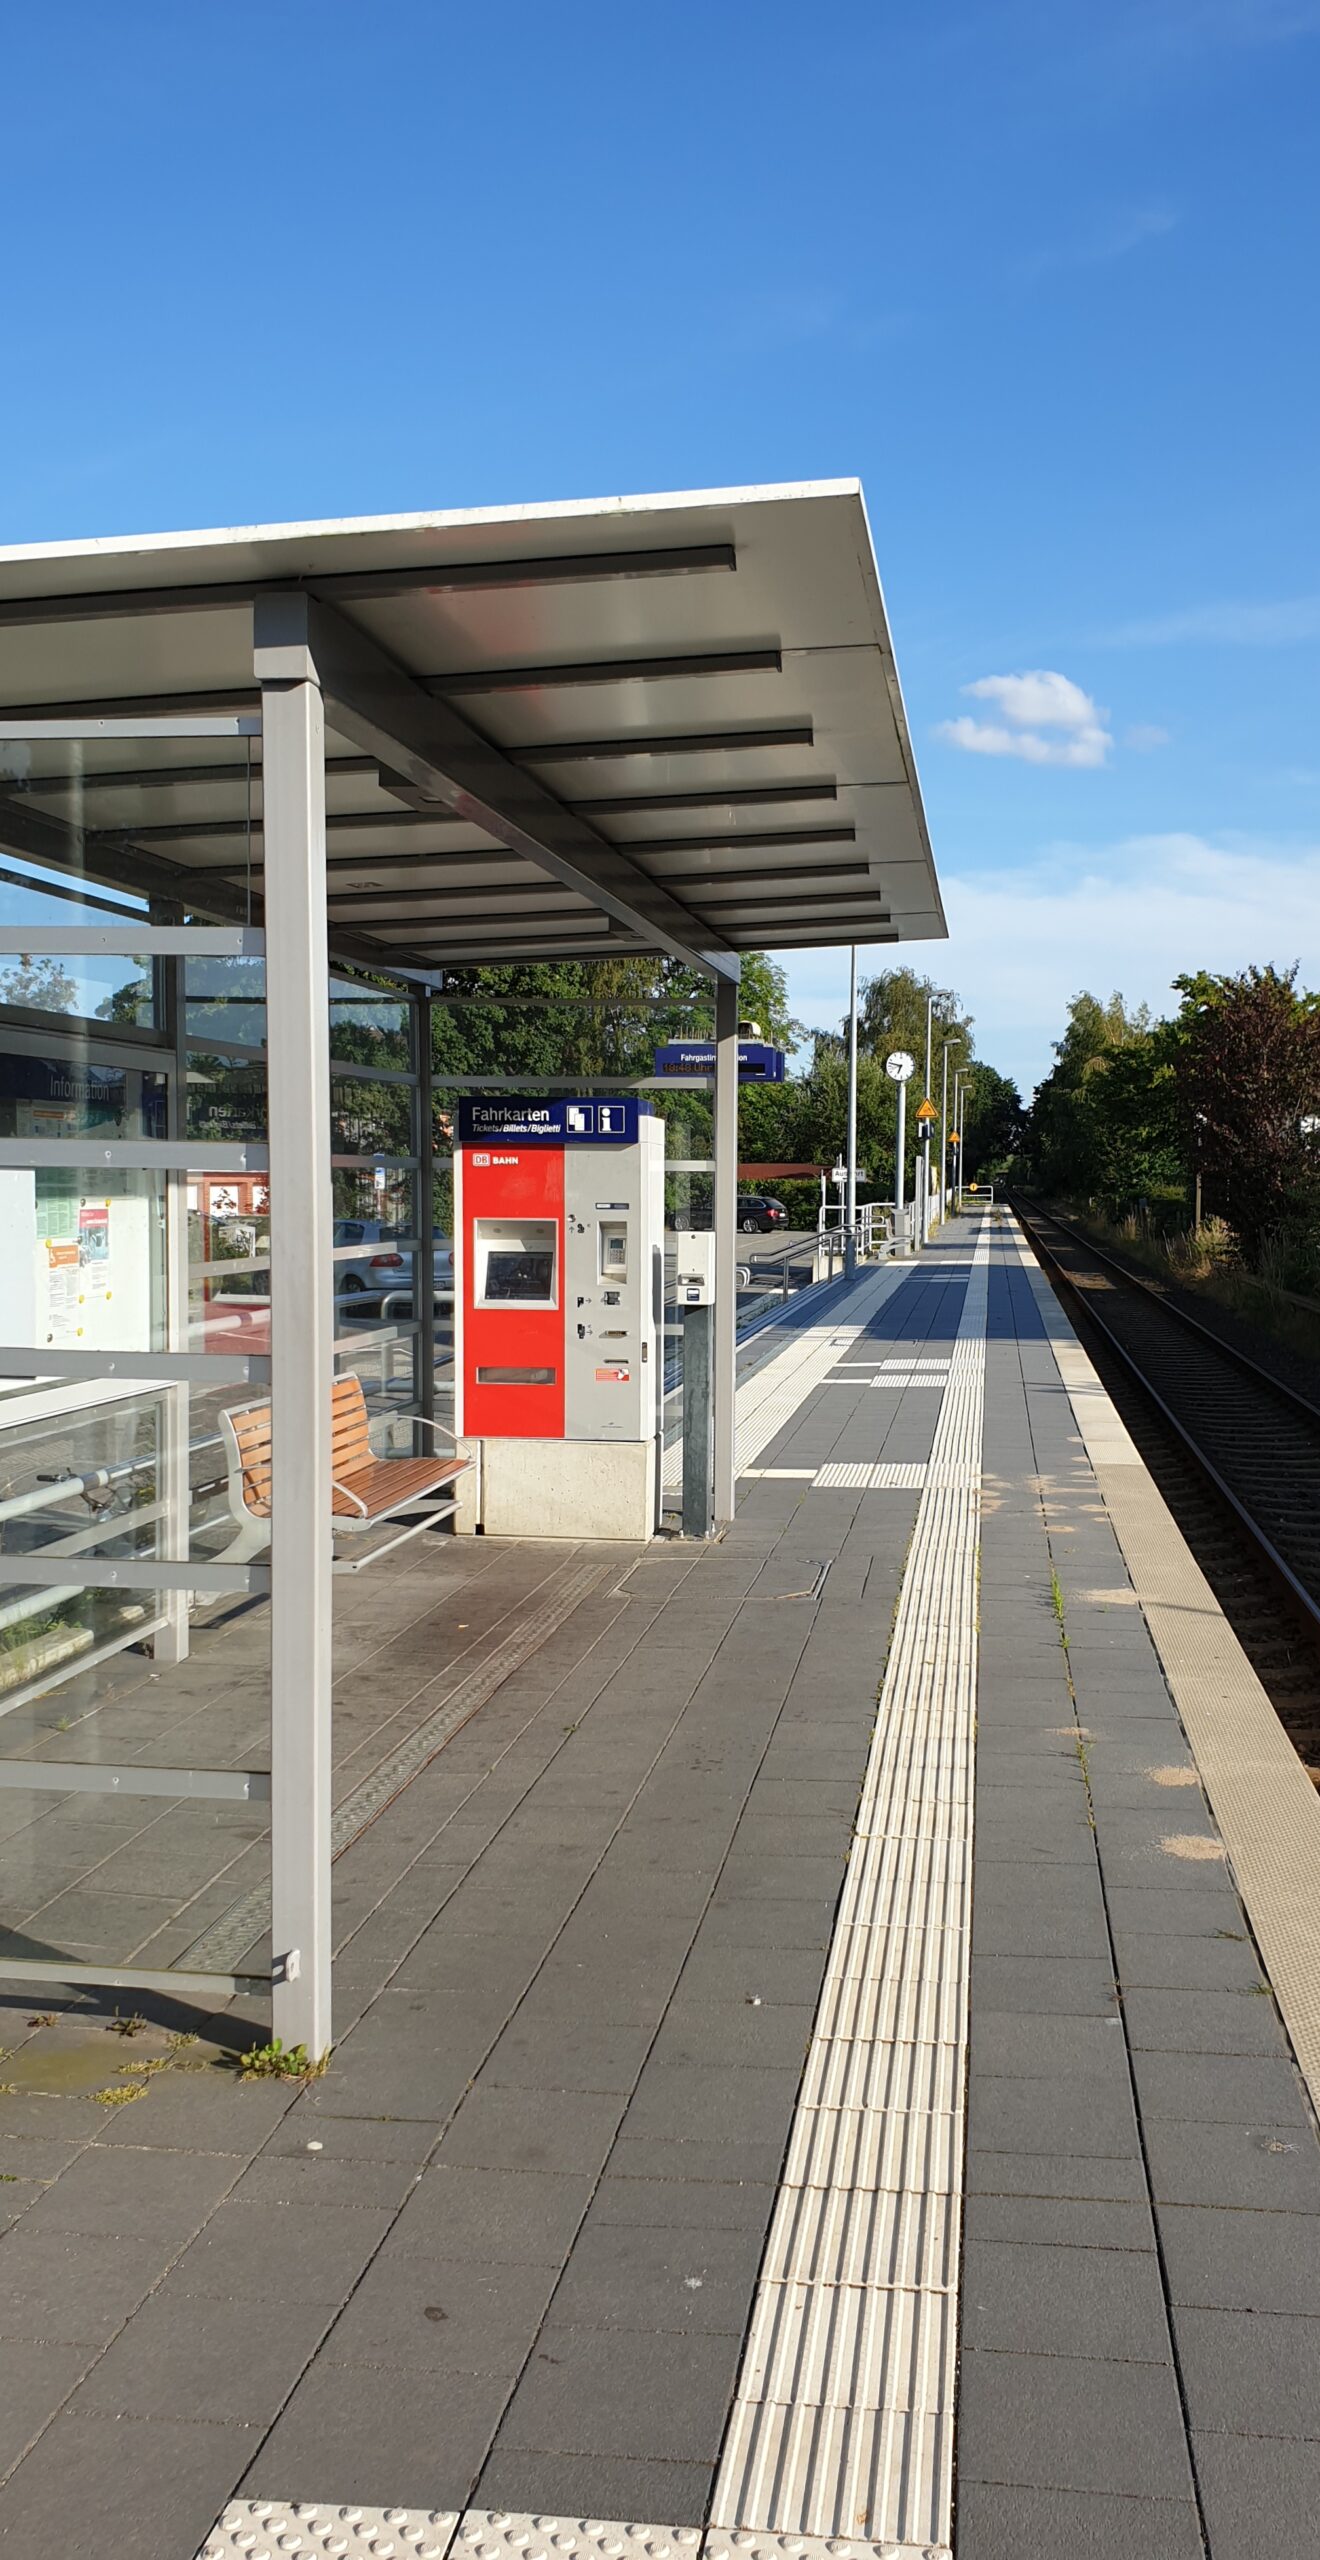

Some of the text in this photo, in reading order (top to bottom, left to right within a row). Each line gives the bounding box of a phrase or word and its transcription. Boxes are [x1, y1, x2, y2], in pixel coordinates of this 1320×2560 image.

[50, 1074, 110, 1101] Information
[472, 1106, 549, 1121] Fahrkarten
[474, 1154, 519, 1165] DB BAHN
